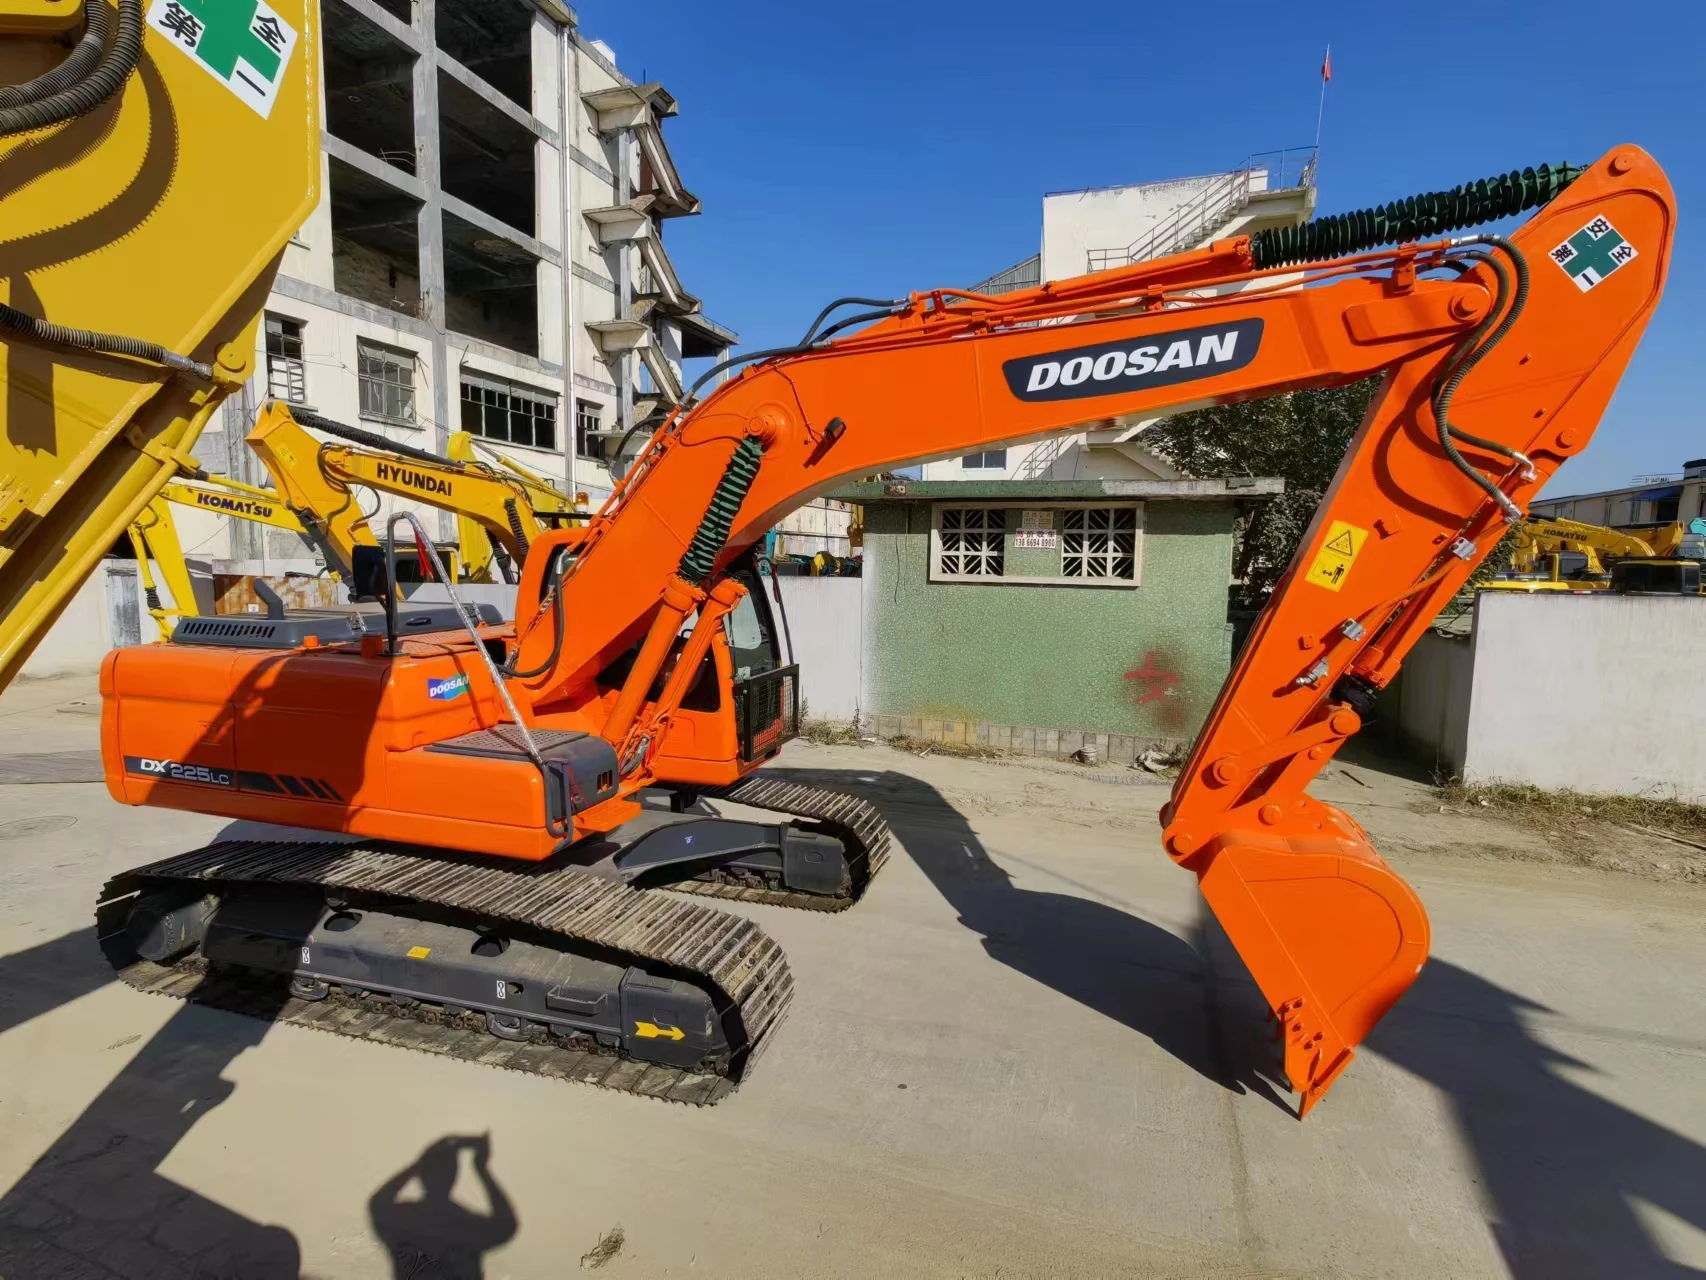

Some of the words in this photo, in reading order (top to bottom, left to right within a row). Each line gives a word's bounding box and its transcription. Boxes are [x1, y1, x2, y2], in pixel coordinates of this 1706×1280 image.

[158, 2, 203, 47] 第
[252, 15, 287, 53] 全
[236, 70, 266, 97] 一
[1586, 218, 1610, 238] 安
[1611, 245, 1632, 264] 全
[1026, 330, 1239, 392] DOOSAN
[377, 463, 453, 497] HYUNDAI
[197, 493, 273, 518] KOMATSU
[1544, 529, 1588, 541] KOMATSU
[430, 676, 469, 697] DOOSAN
[140, 758, 172, 773] DX
[170, 763, 230, 785] 225LC
